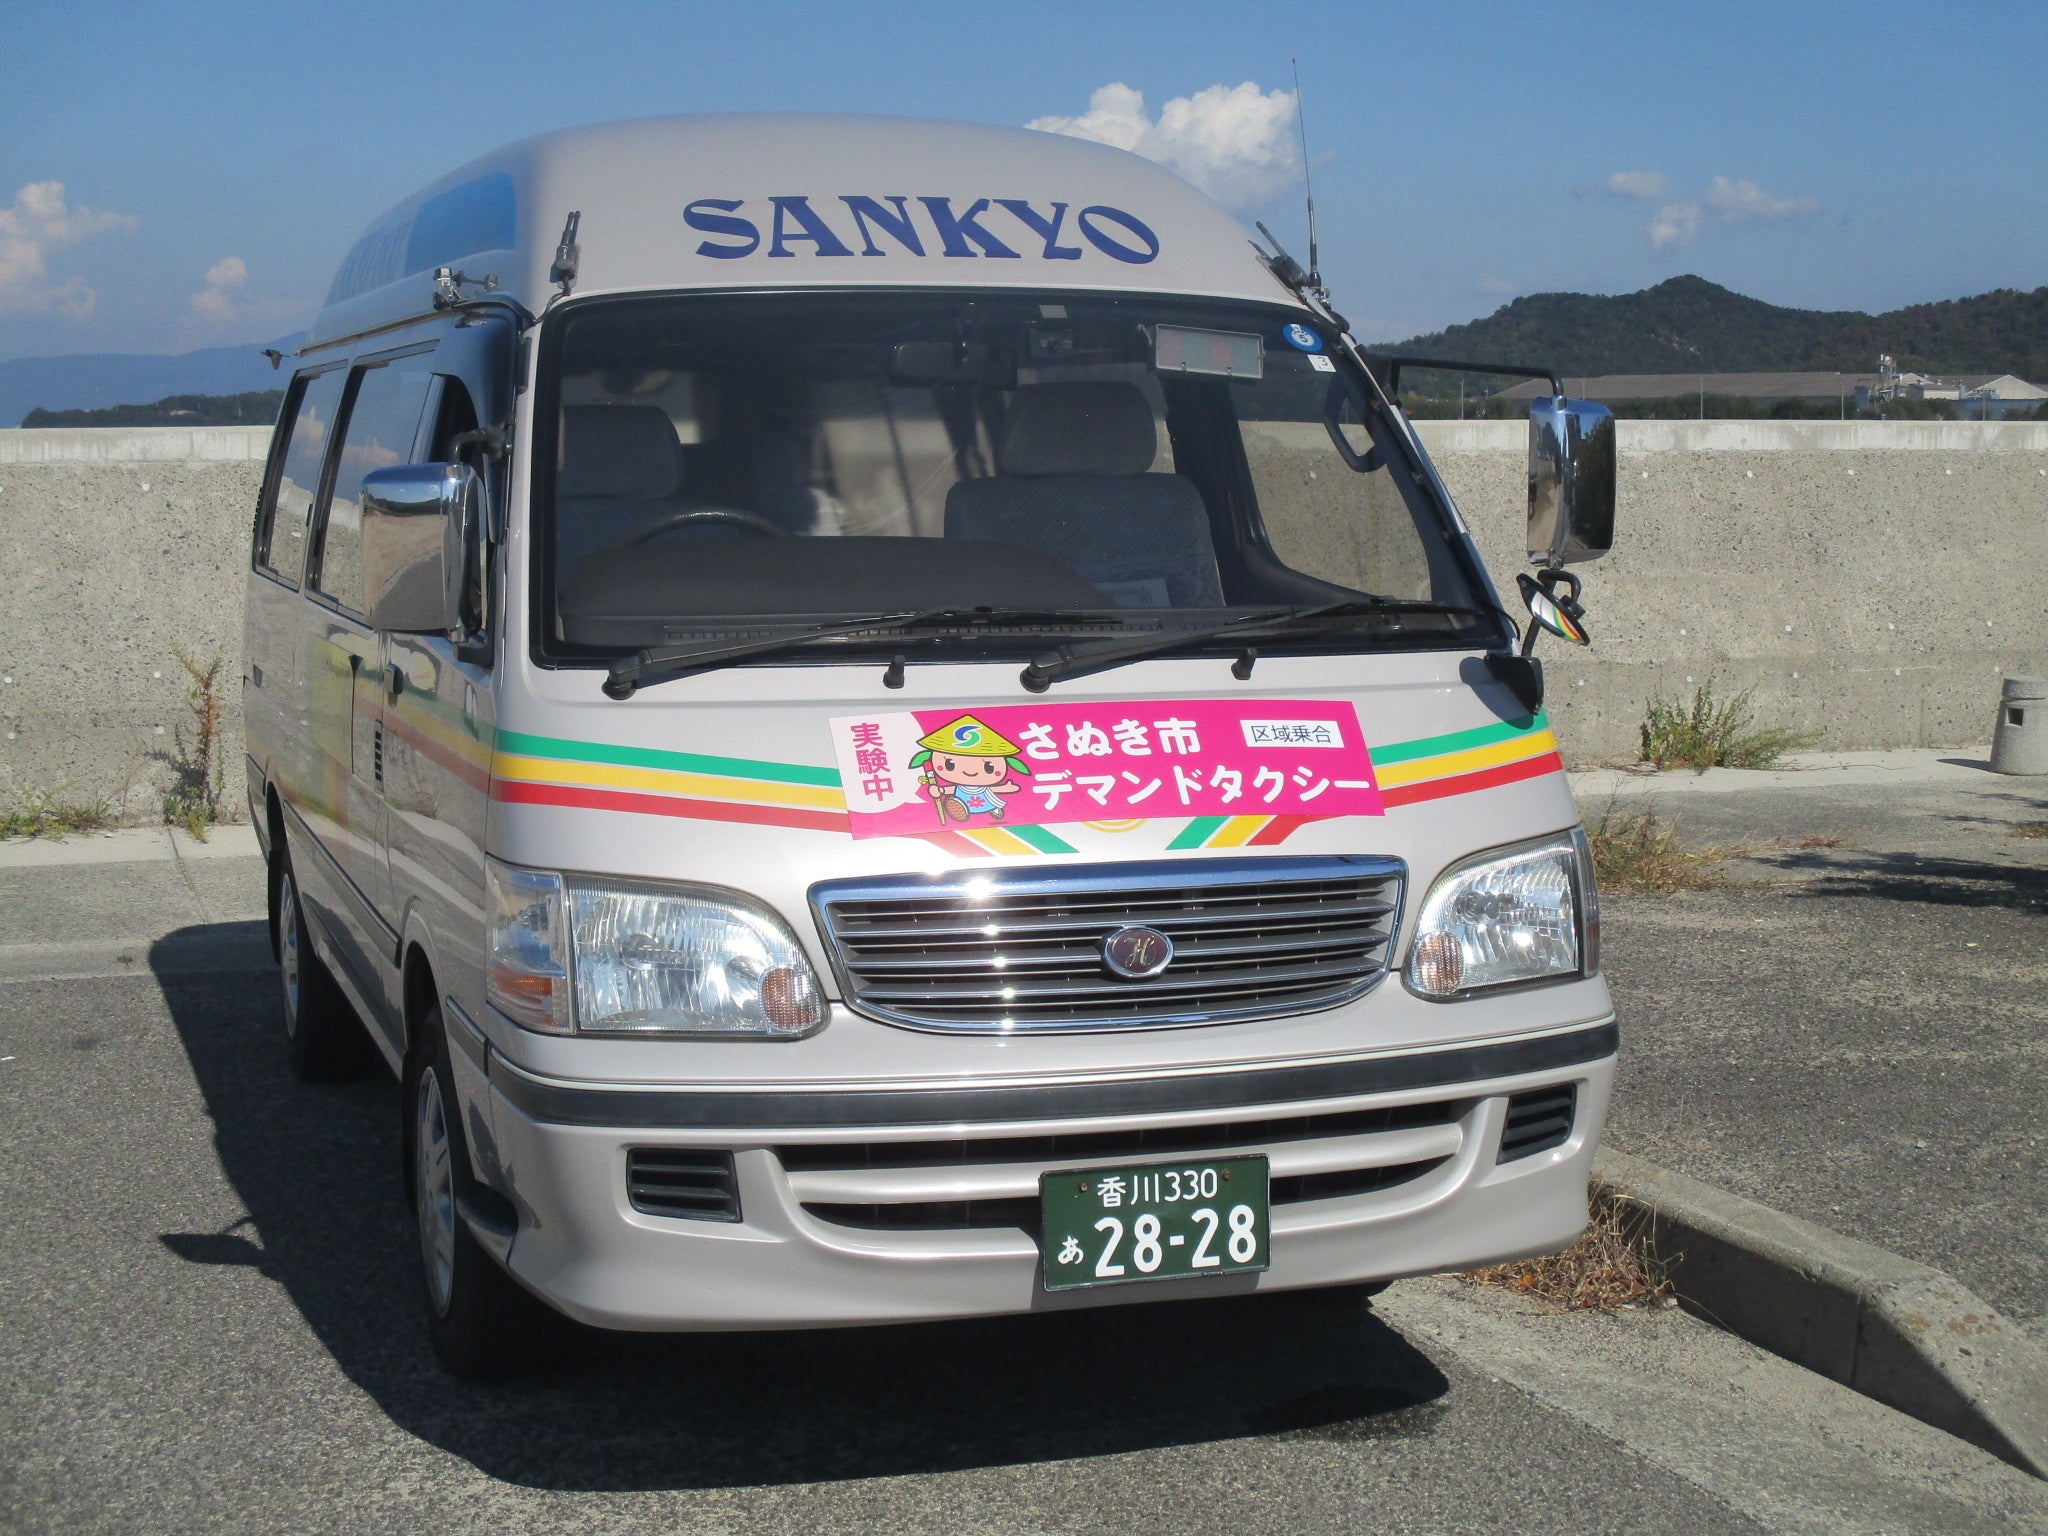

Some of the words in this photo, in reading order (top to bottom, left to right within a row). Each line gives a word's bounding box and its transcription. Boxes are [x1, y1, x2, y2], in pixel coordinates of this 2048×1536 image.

[682, 195, 1160, 265] SANKYO
[850, 722, 894, 802] 実験中
[1018, 717, 1201, 761] さぬき市
[1250, 724, 1332, 744] 区域乗合
[1031, 766, 1370, 811] デマンドタクシー
[1094, 1204, 1257, 1278] 28-28
